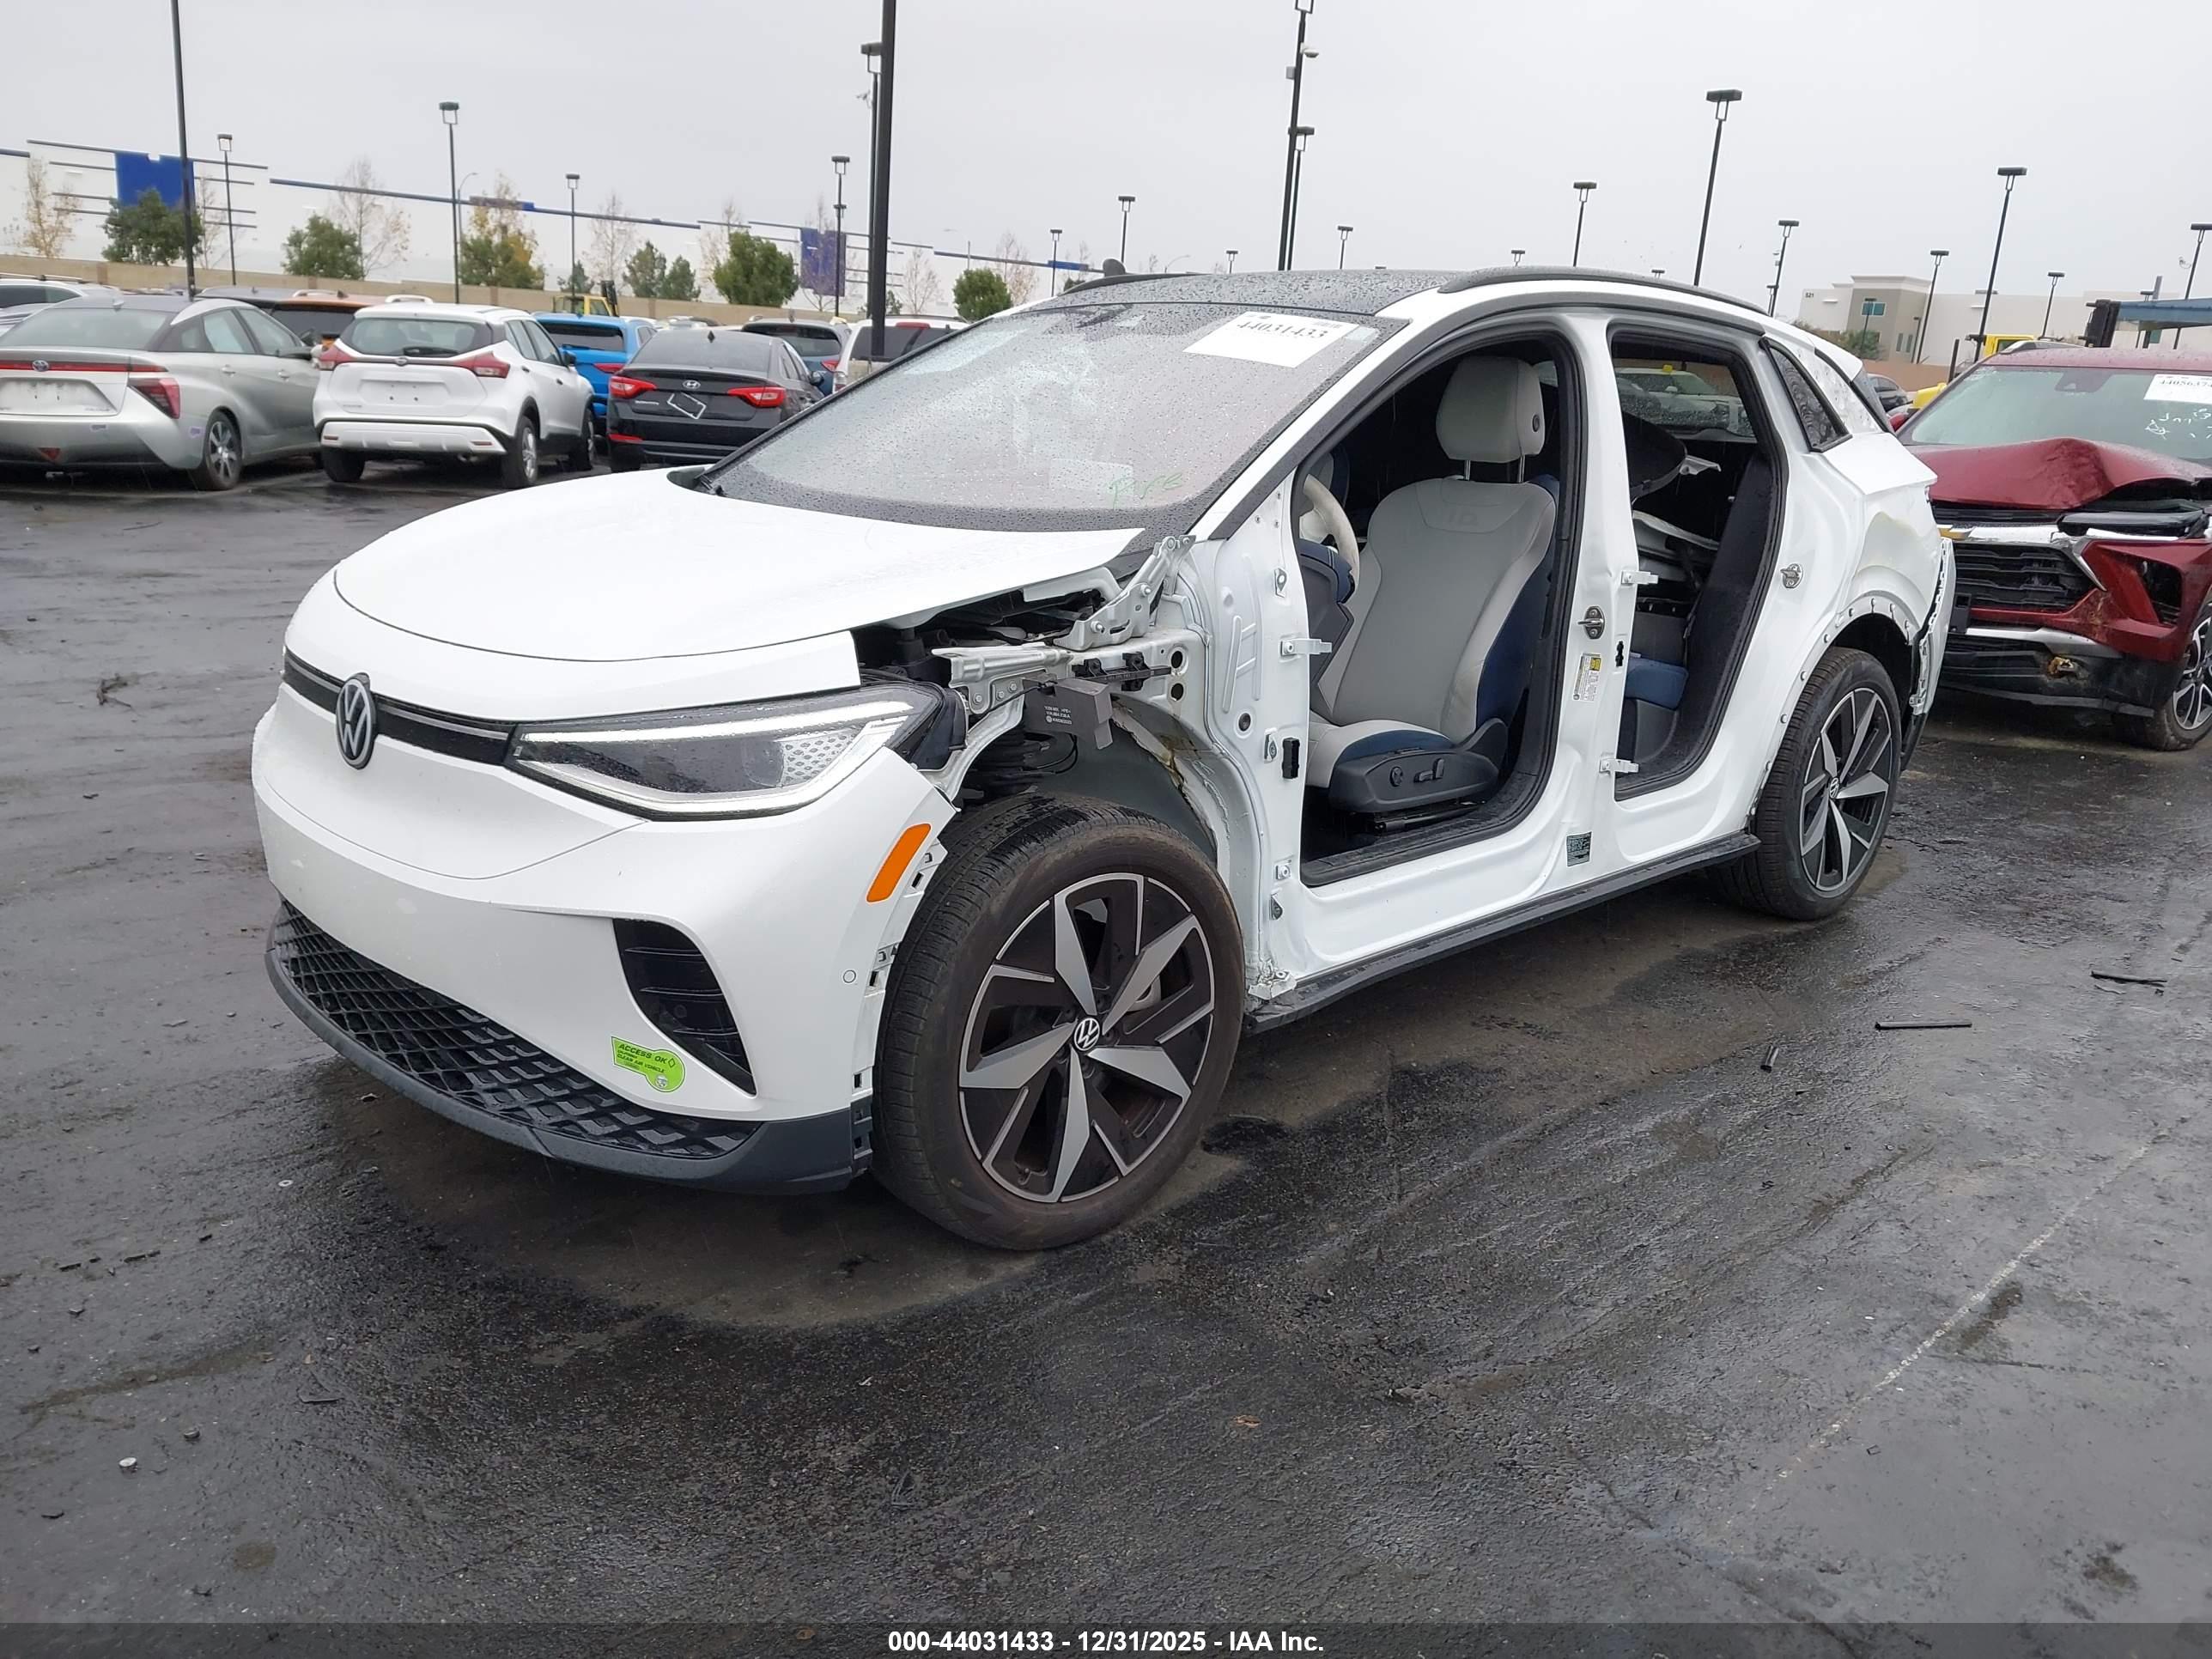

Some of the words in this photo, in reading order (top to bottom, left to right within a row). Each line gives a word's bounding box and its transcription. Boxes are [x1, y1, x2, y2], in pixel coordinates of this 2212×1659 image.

[1237, 321, 1329, 338] 44031433
[618, 1043, 653, 1059] ACCESS
[654, 1055, 668, 1064] OK
[617, 1054, 634, 1062] CLEAN
[644, 1063, 665, 1073] VEHICLE
